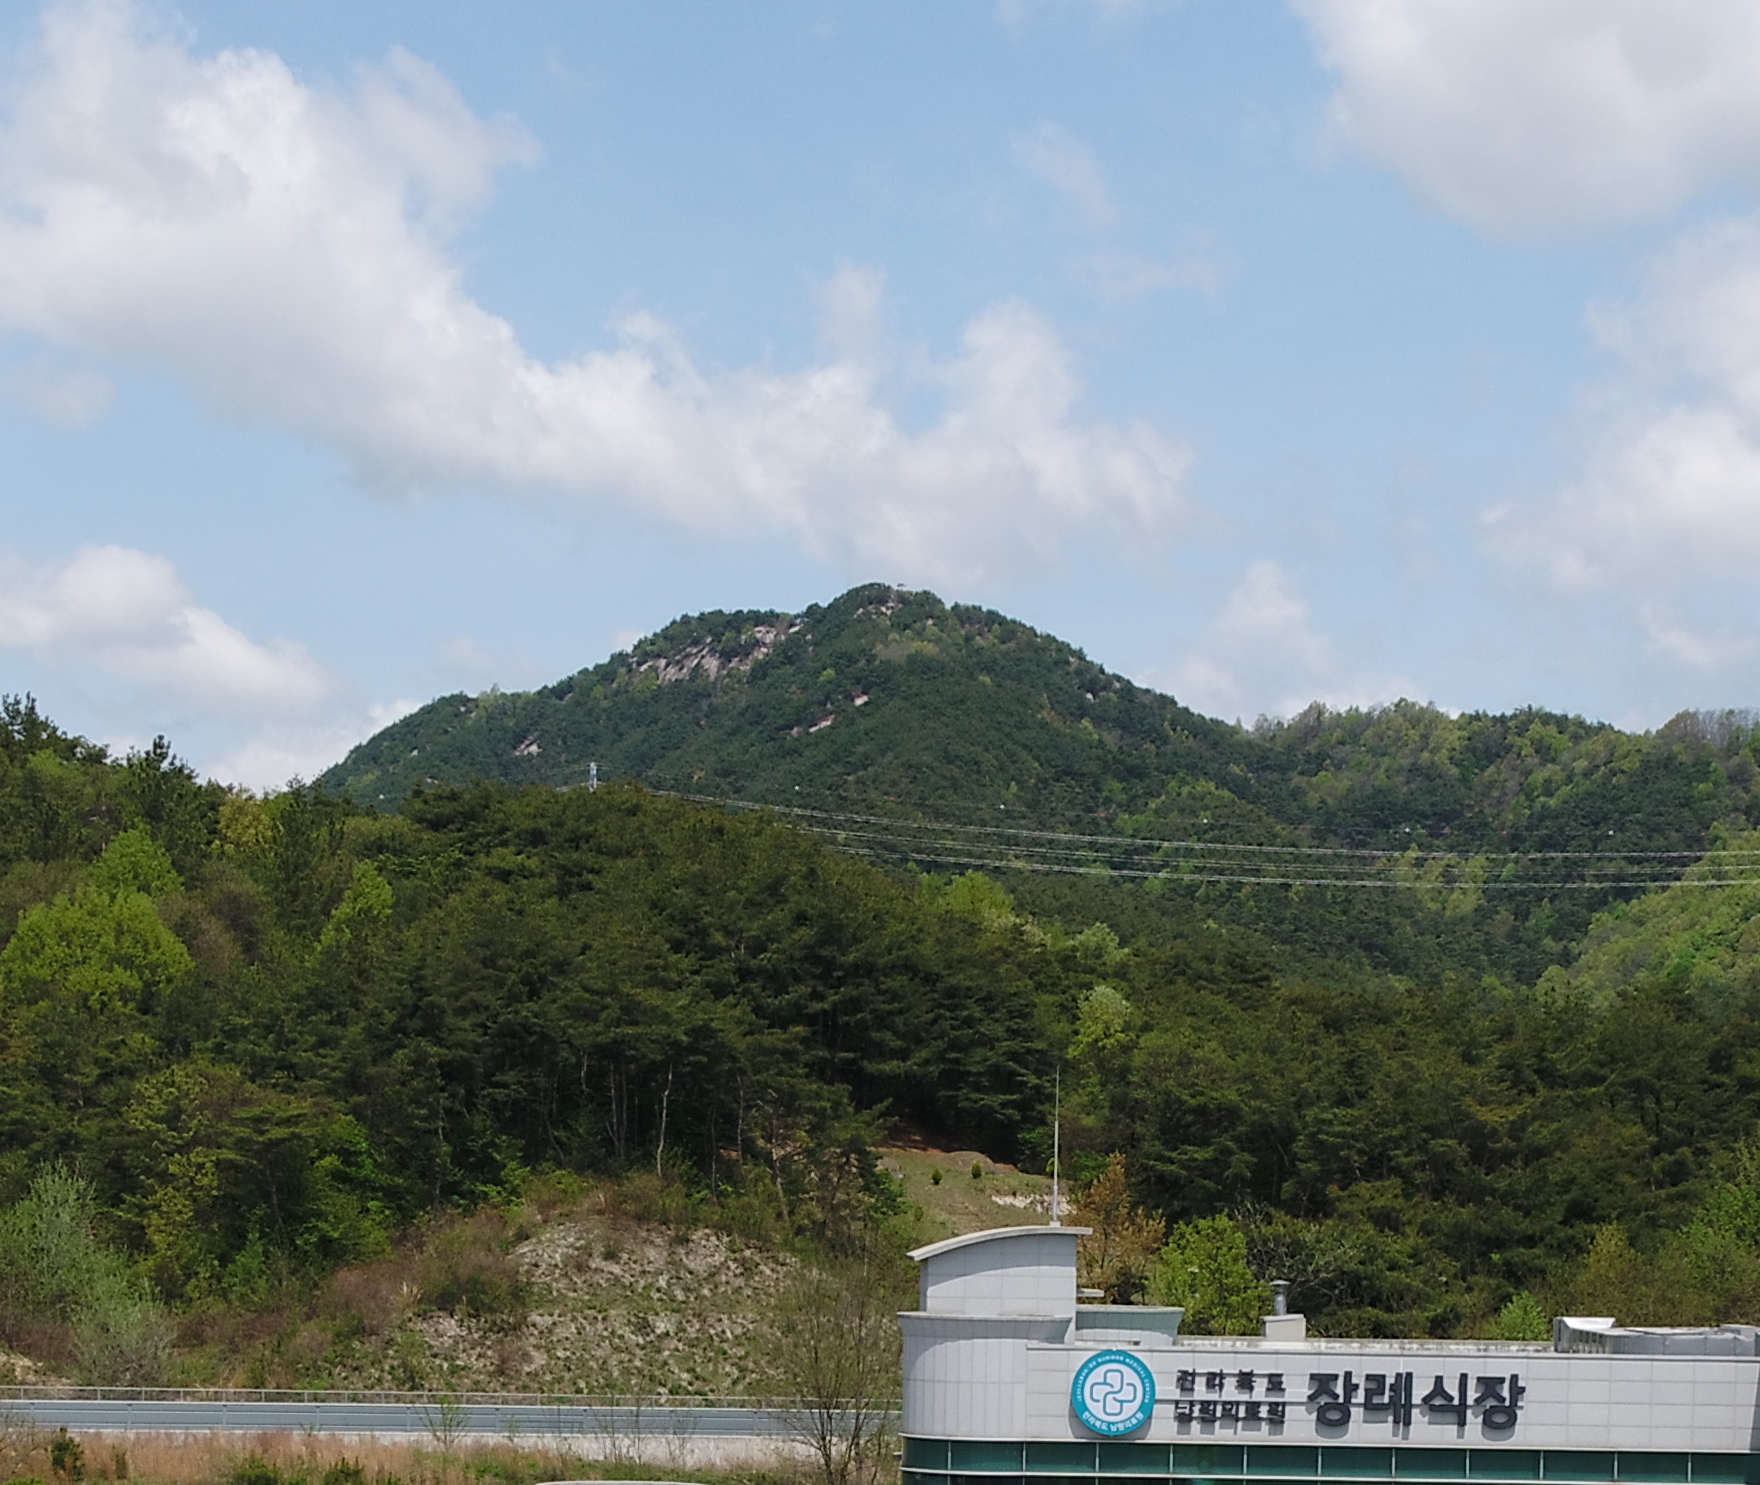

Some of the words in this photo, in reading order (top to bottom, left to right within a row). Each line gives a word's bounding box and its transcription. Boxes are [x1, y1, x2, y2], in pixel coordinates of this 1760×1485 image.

[1176, 1368, 1286, 1392] 전라북도
[1175, 1400, 1286, 1424] 남원의료원
[1307, 1371, 1526, 1430] 장례식장
